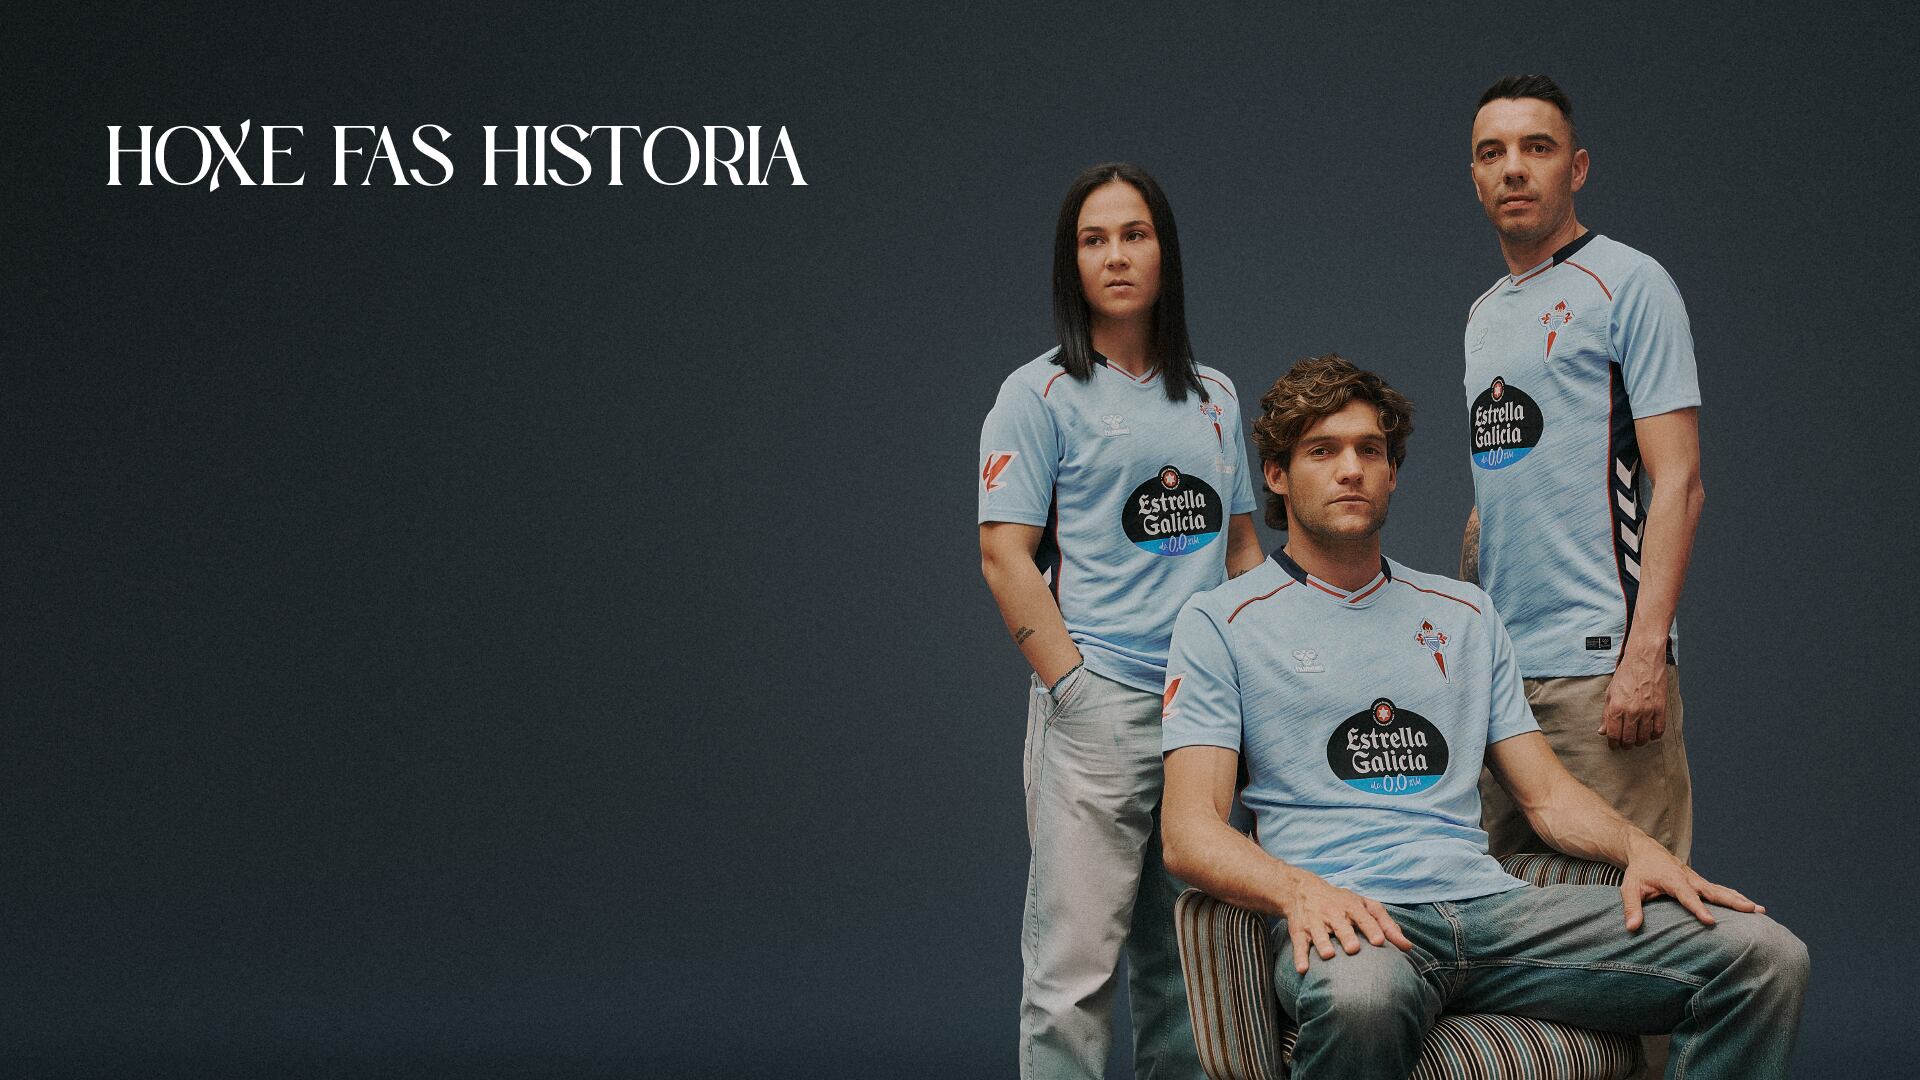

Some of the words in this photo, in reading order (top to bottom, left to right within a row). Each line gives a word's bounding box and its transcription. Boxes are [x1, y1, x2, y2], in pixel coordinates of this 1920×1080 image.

[1475, 401, 1525, 427] Estrella
[1475, 423, 1522, 448] Galicia
[1138, 490, 1206, 515] Estrella
[1143, 510, 1206, 535] Galicia
[1168, 533, 1187, 552] 0,0
[1346, 727, 1428, 751] Estrella
[1352, 749, 1429, 774] Galicia
[1383, 773, 1407, 792] 0,0
